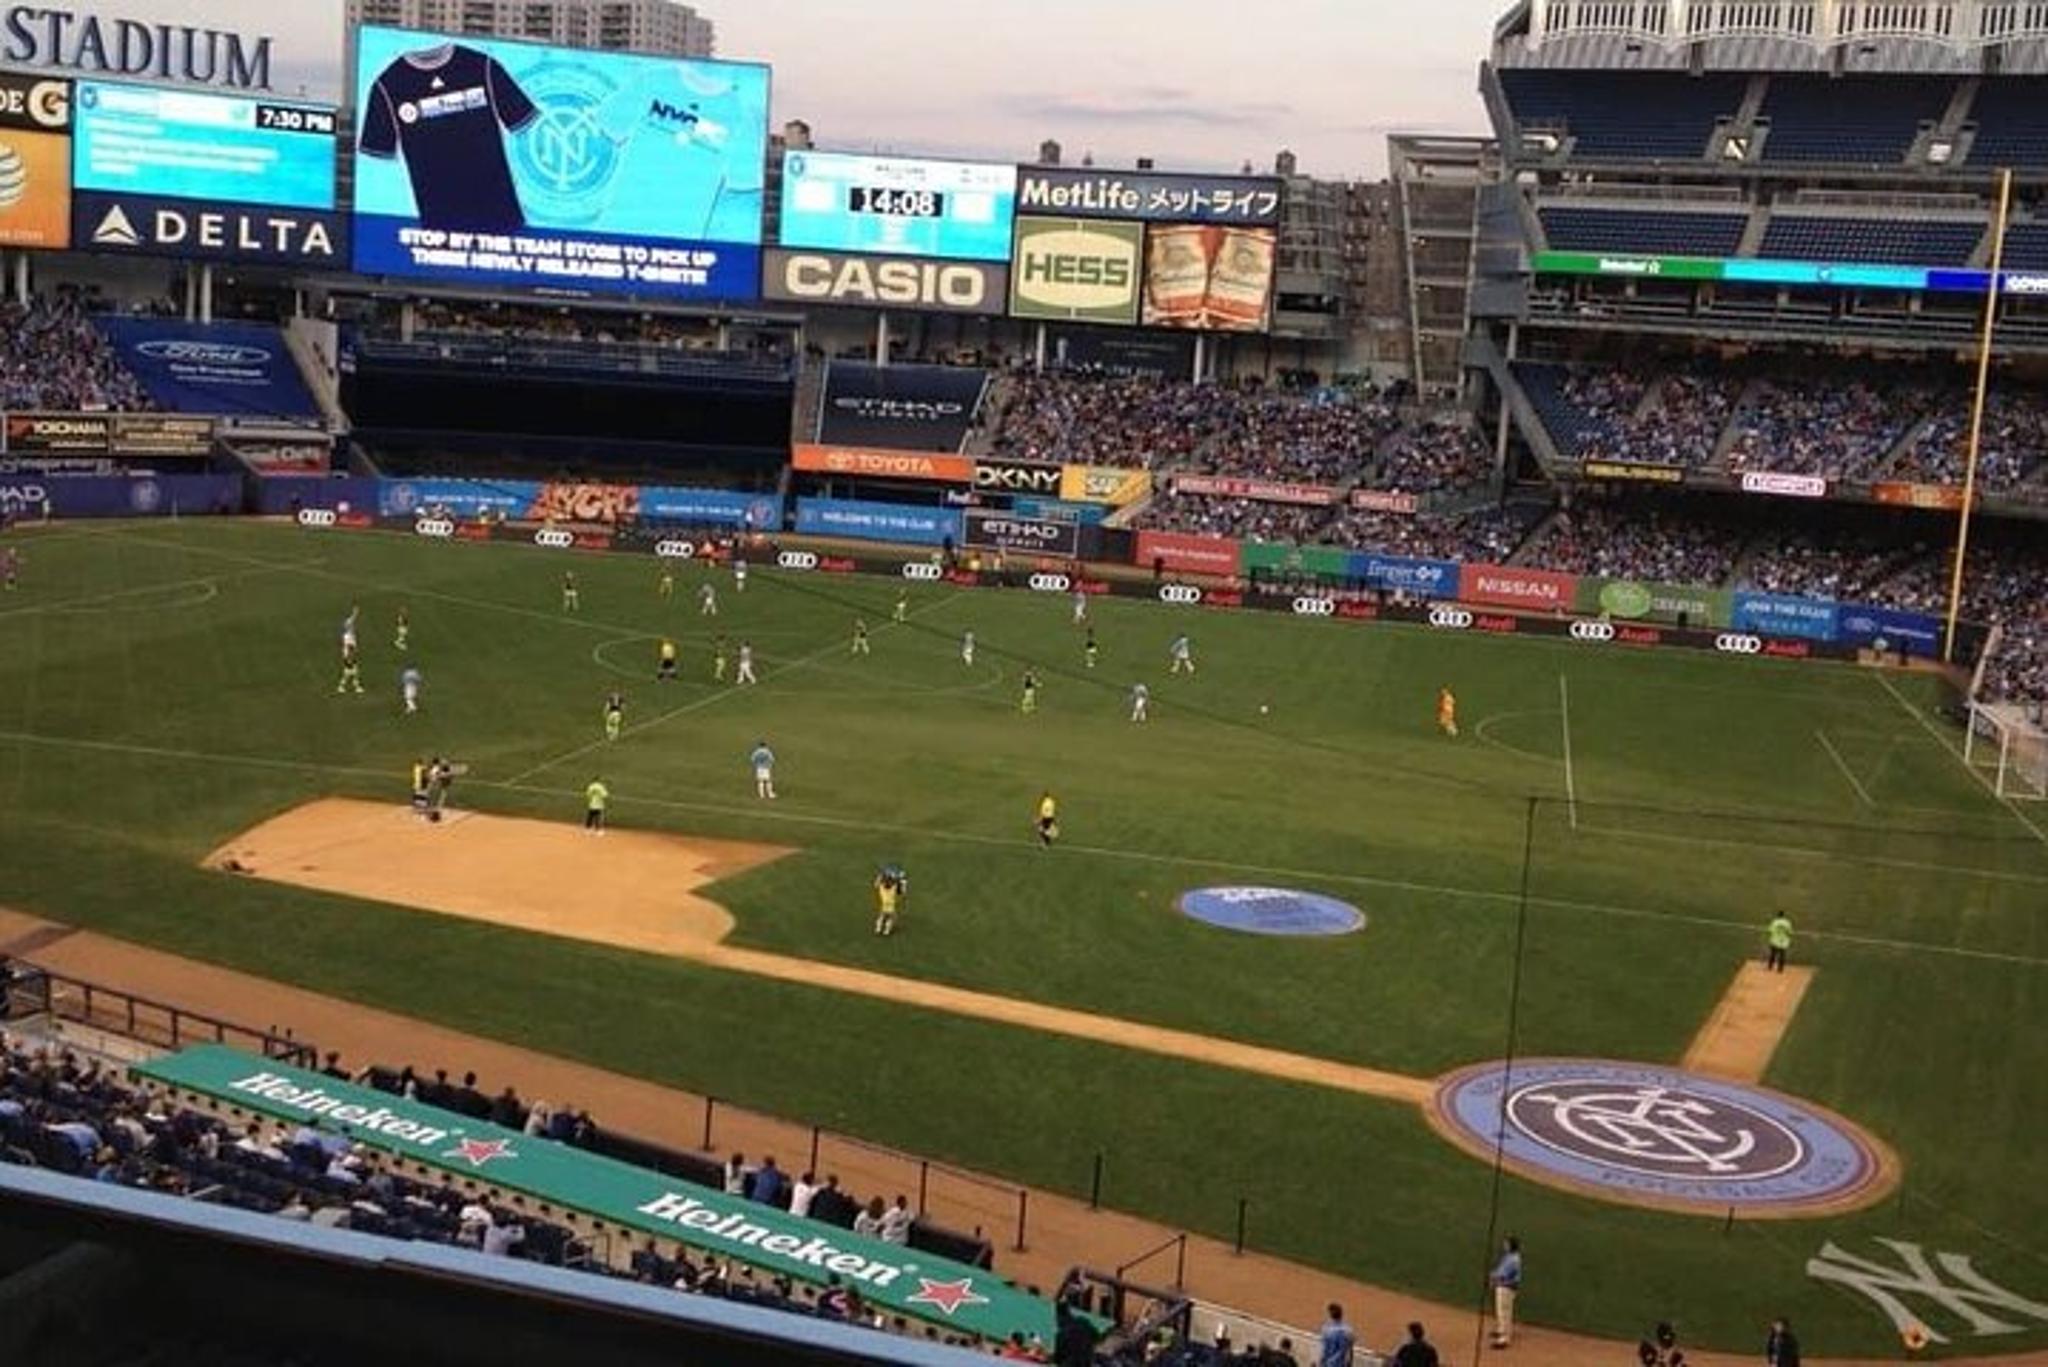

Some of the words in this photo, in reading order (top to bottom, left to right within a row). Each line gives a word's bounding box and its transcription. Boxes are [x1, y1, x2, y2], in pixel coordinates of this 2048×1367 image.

[5, 6, 274, 92] STADIUM
[262, 108, 302, 129] 7:30
[305, 113, 334, 131] PM
[861, 189, 935, 216] 14:08
[1022, 178, 1140, 209] MetLife
[1149, 187, 1278, 215] メットライフ
[155, 210, 334, 254] DELTA
[785, 255, 985, 307] CASIO
[1025, 251, 1129, 287] HESS
[859, 454, 935, 473] TOYOTA
[974, 465, 1061, 491] DKNY
[981, 519, 1059, 539] ETIHAD
[1477, 577, 1559, 599] NISSAN
[228, 1072, 447, 1145] Heineken
[636, 1191, 901, 1286] Heineken
